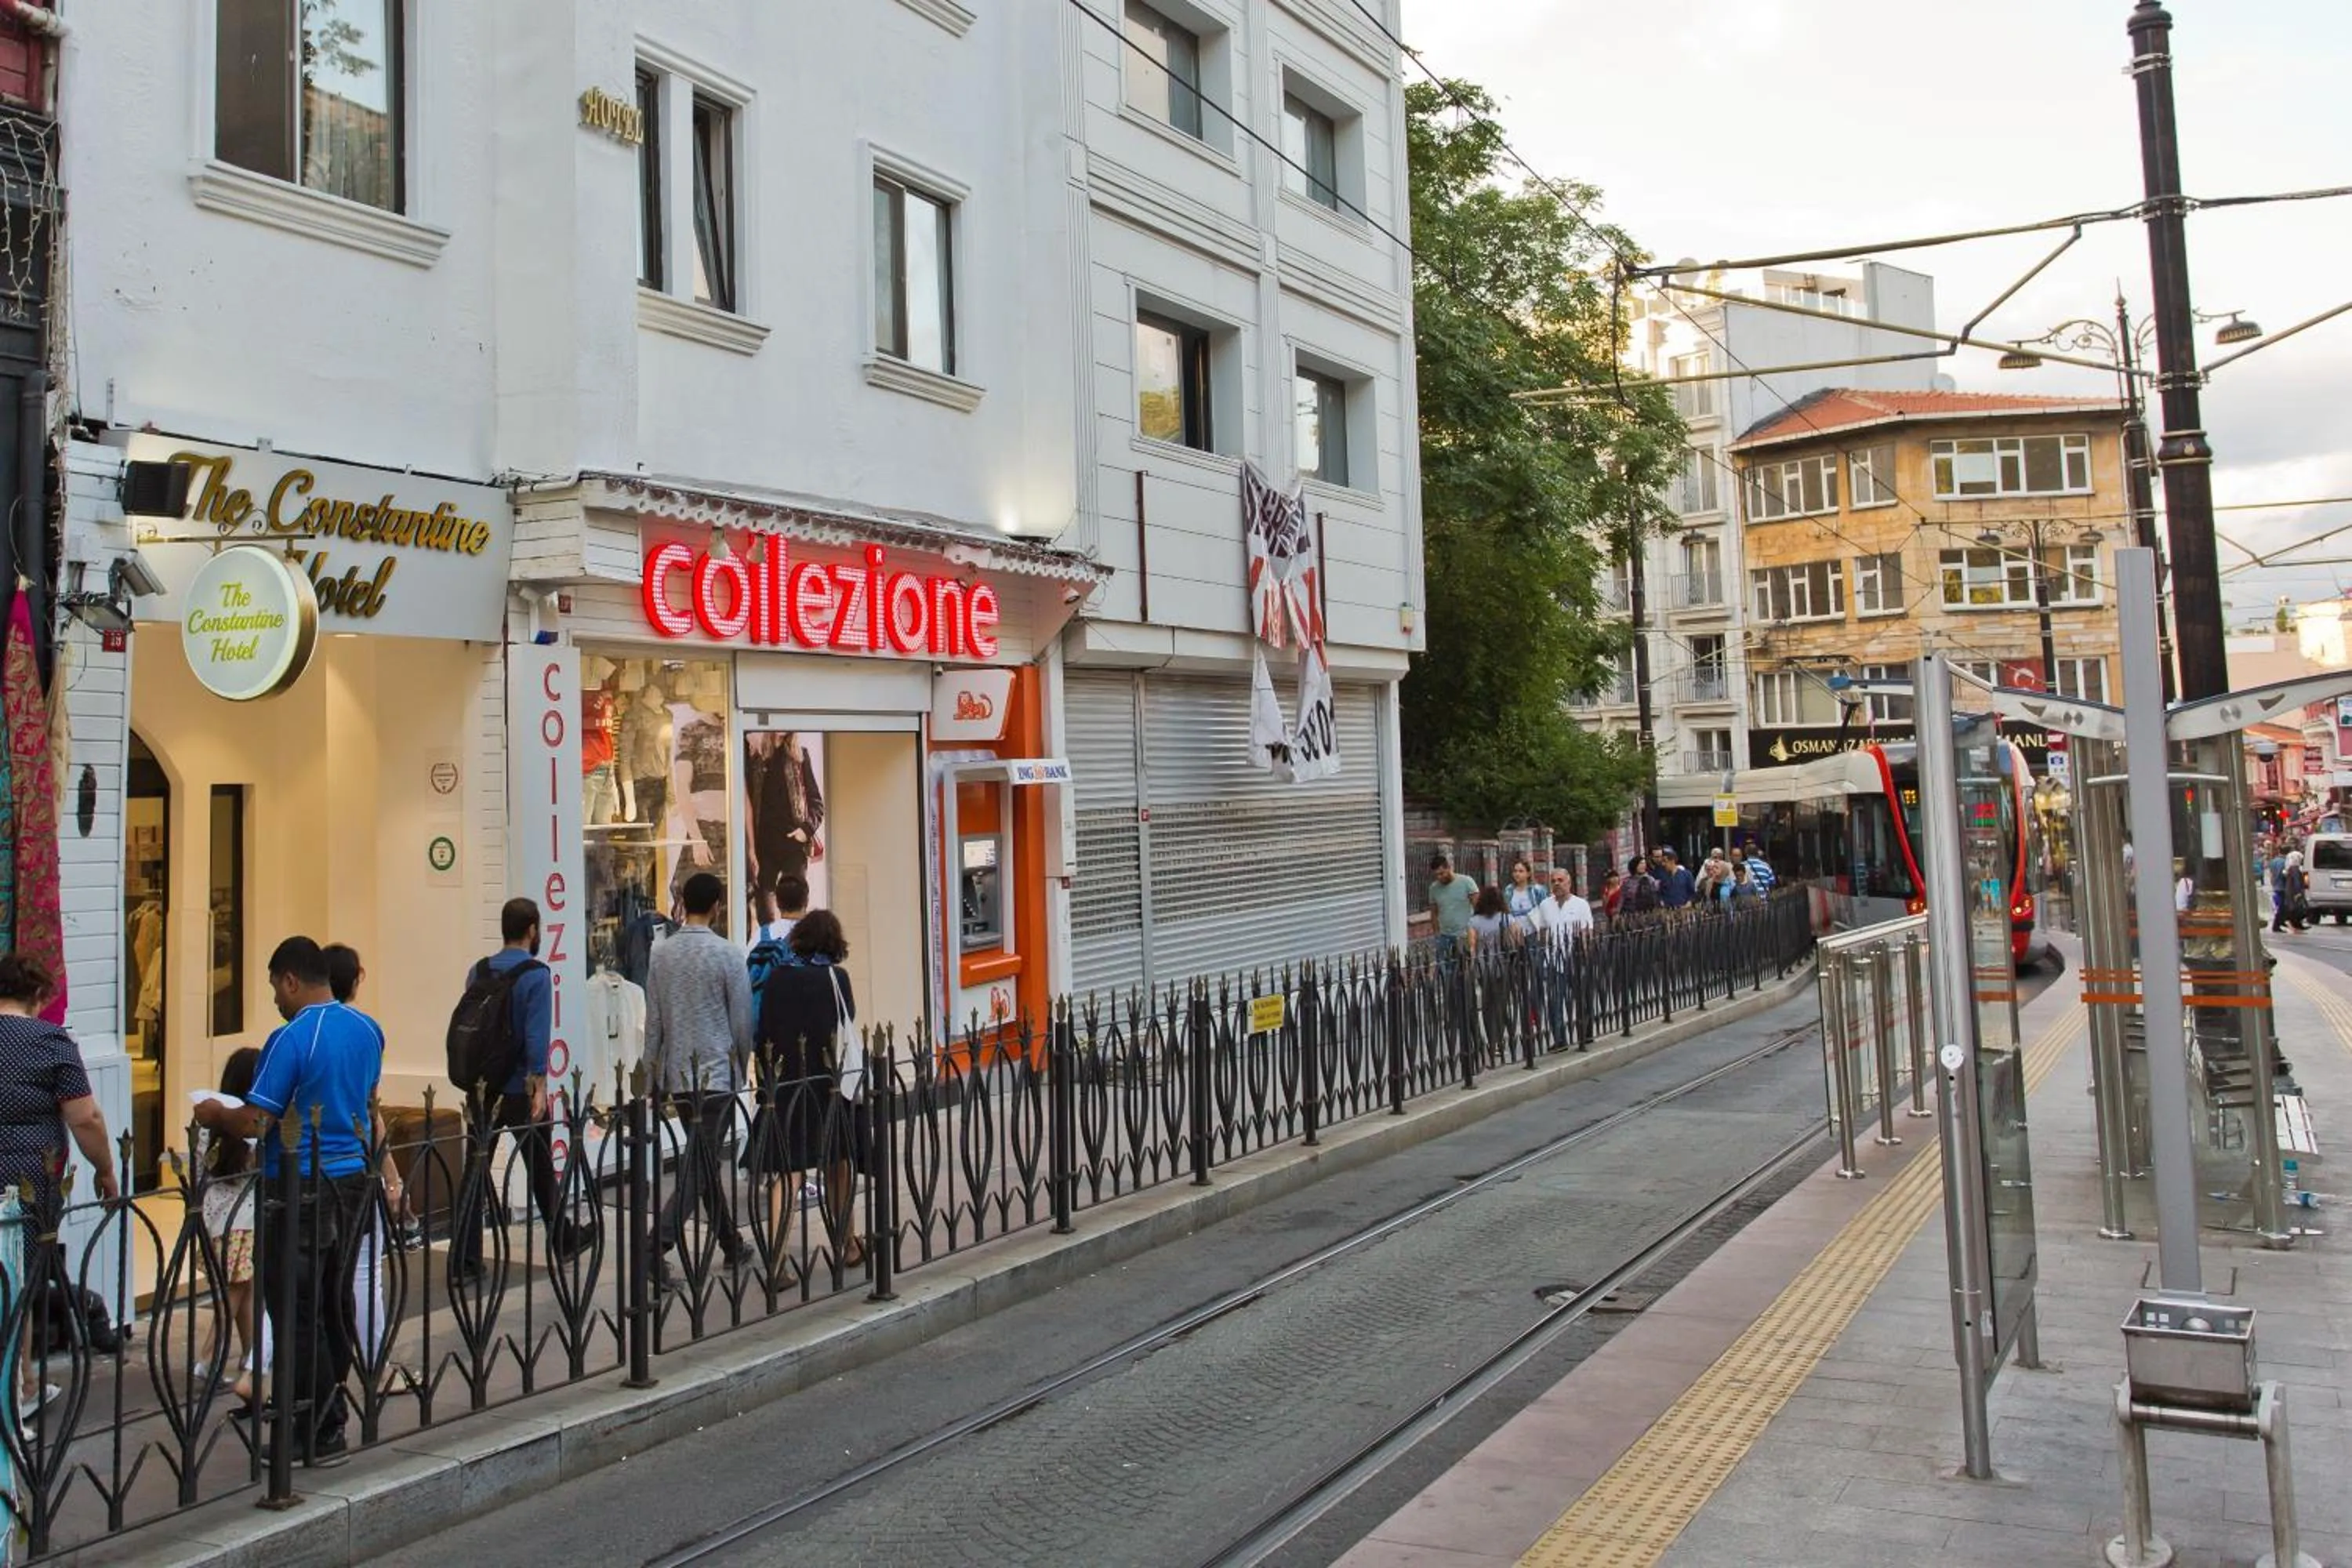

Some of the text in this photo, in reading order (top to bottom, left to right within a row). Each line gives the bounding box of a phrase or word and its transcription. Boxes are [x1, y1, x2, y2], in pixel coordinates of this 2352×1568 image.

[579, 87, 644, 143] HOTEL
[167, 451, 492, 556] The Constantine
[220, 581, 252, 608] The
[642, 531, 1001, 657] collezione
[187, 608, 285, 635] Constantine
[210, 635, 260, 663] Hotel
[1018, 764, 1067, 780] ING BANK
